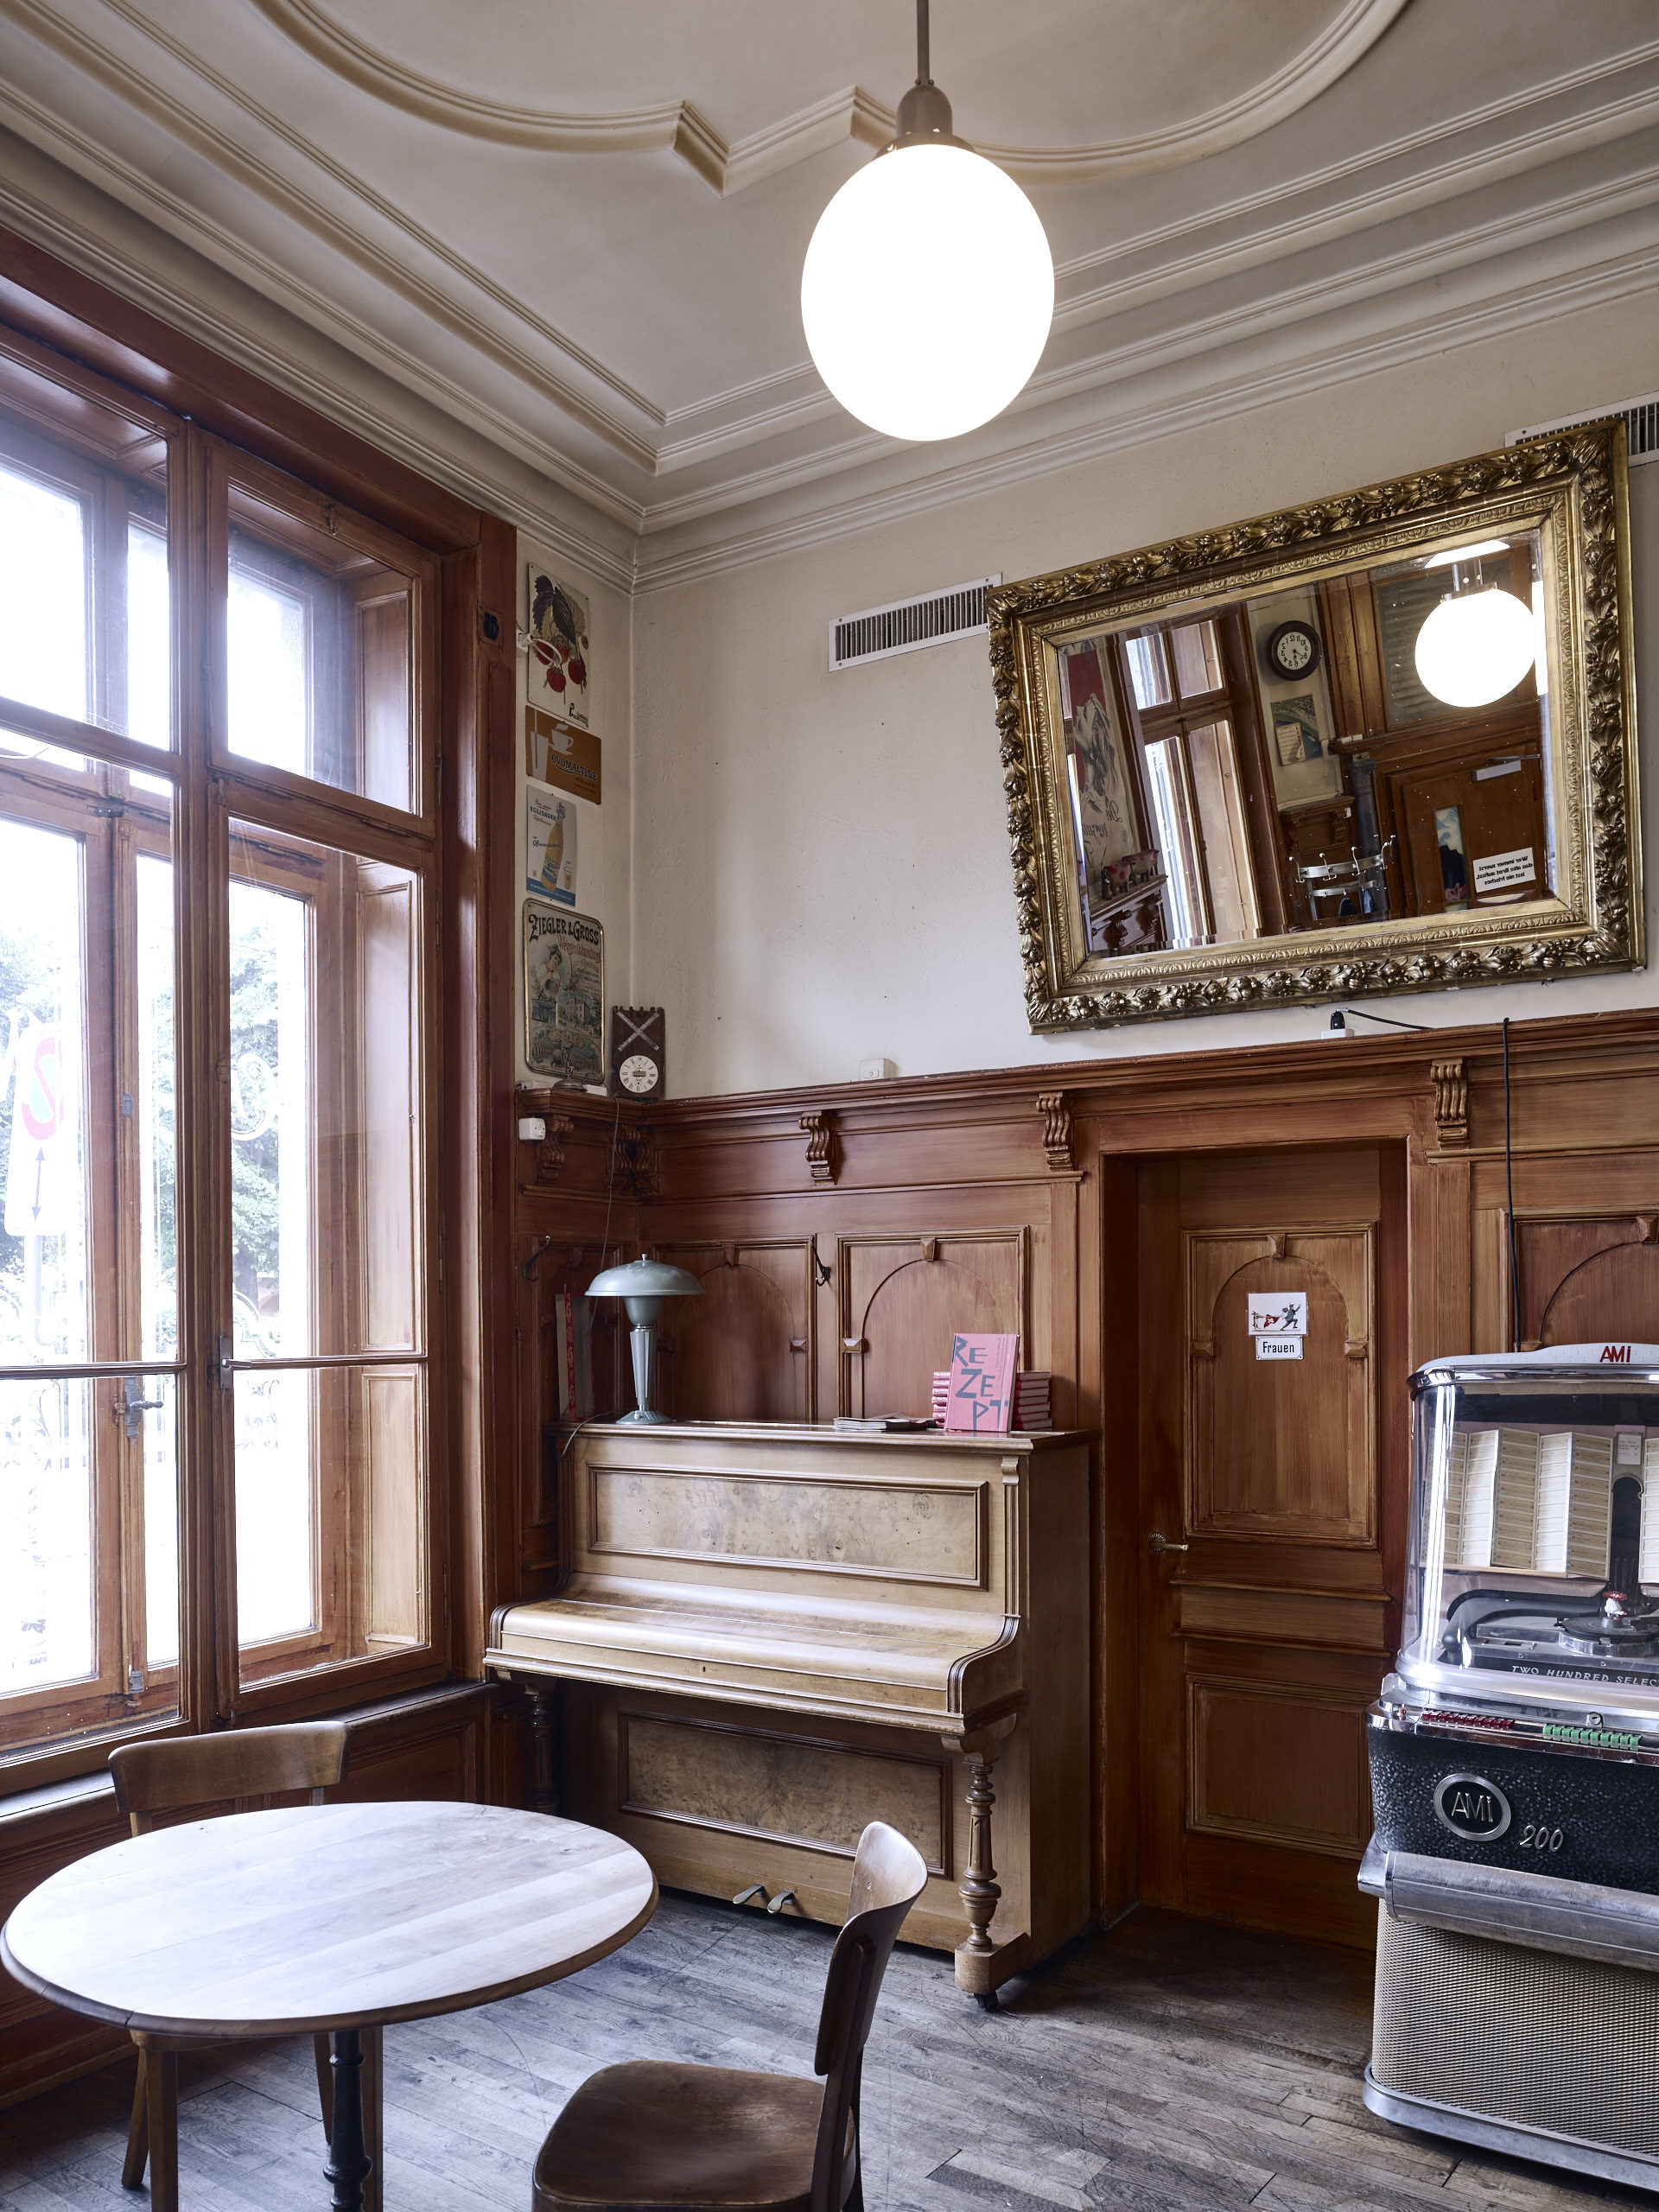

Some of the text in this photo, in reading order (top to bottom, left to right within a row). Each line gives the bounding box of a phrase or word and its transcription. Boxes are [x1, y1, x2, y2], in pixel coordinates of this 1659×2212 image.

[551, 754, 598, 781] OVOMALTINE
[529, 913, 567, 943] ZIEGLER
[573, 920, 599, 945] GROSS
[1262, 1341, 1294, 1353] Frauen
[1512, 1665, 1659, 1687] TWO HUNDRED SELEC
[1519, 1824, 1564, 1852] 200
